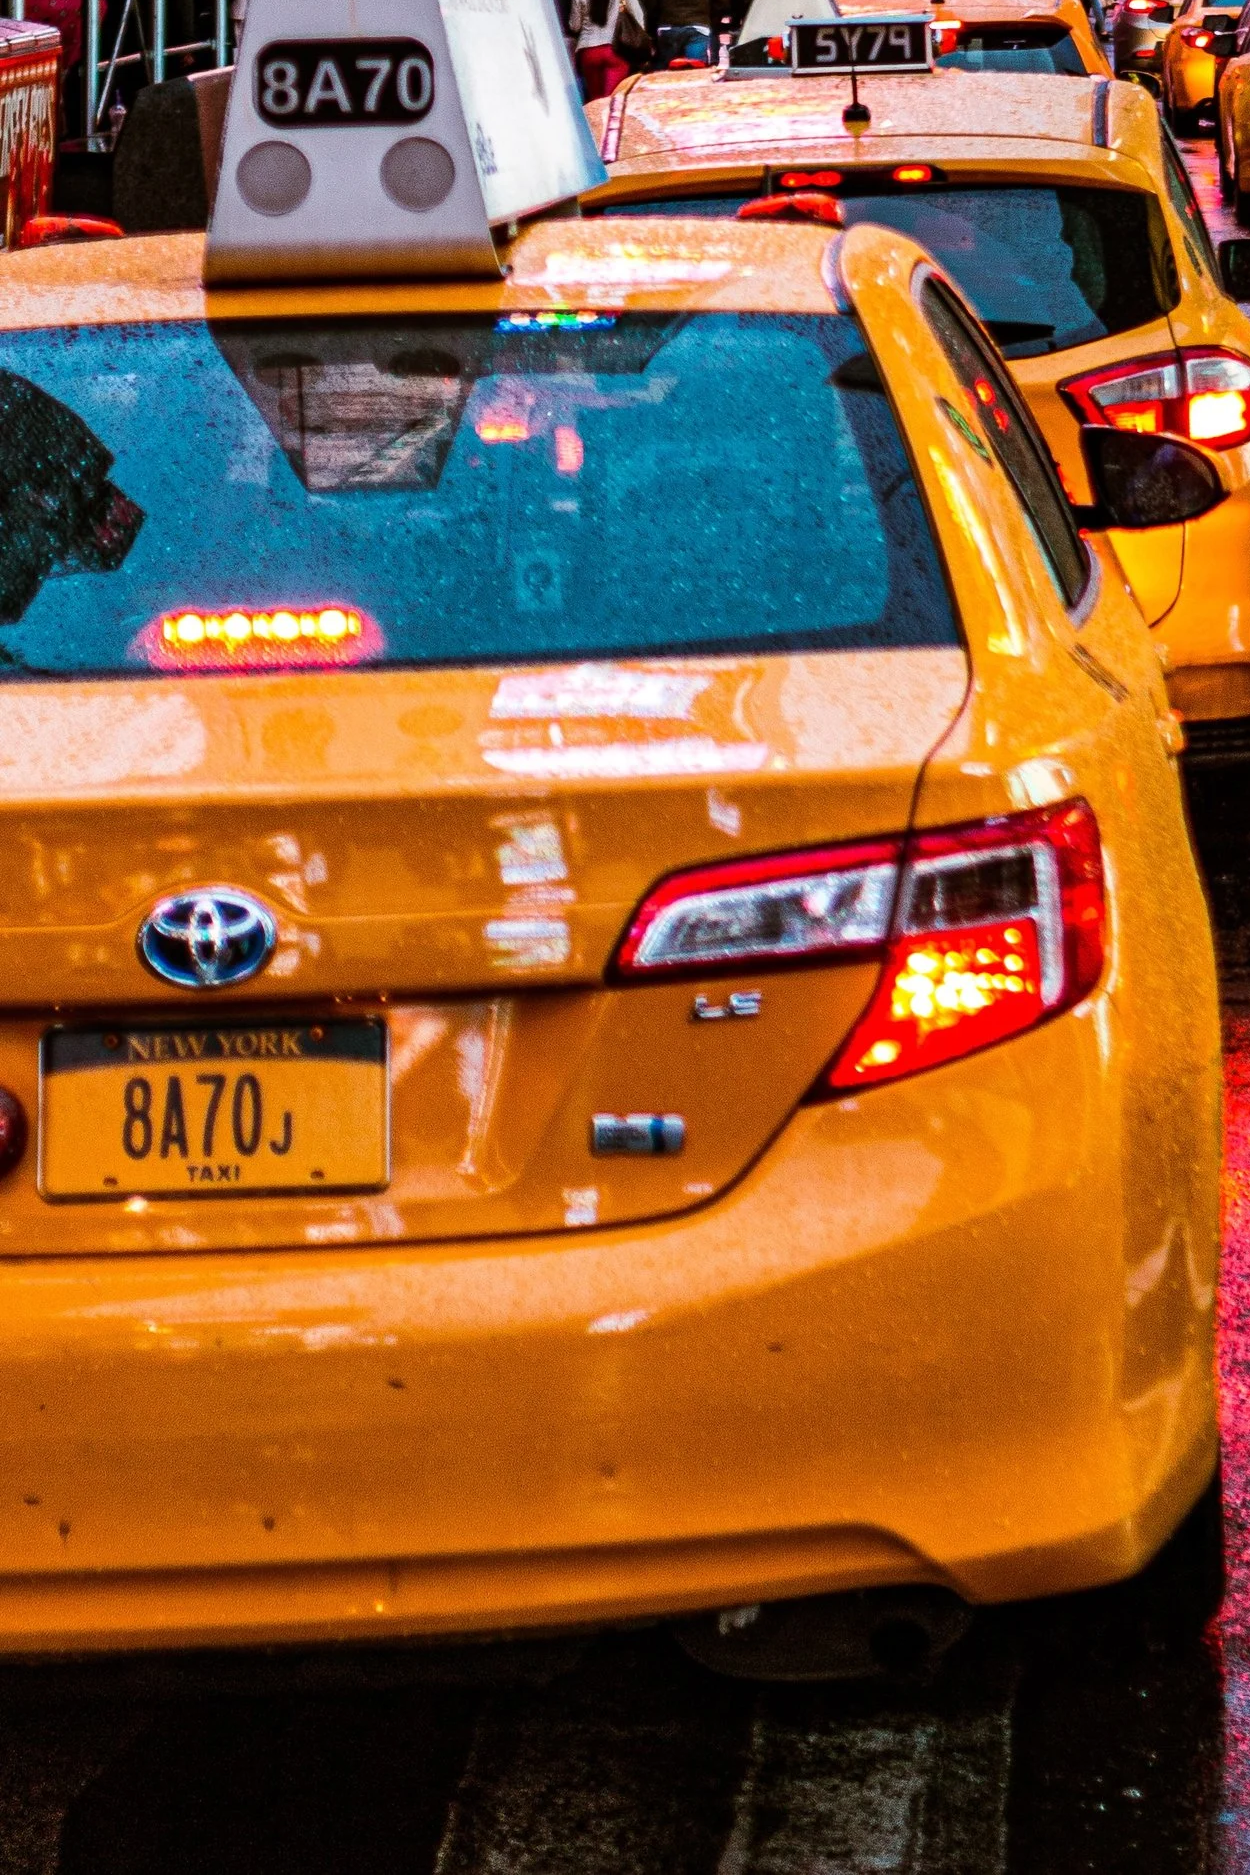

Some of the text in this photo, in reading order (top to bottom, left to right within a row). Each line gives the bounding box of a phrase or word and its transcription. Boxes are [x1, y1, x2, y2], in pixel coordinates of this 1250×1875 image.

[262, 55, 432, 115] 8A70
[127, 1032, 302, 1060] NEW YORK
[122, 1072, 293, 1160] 8A70J
[187, 1165, 241, 1182] TAXI
